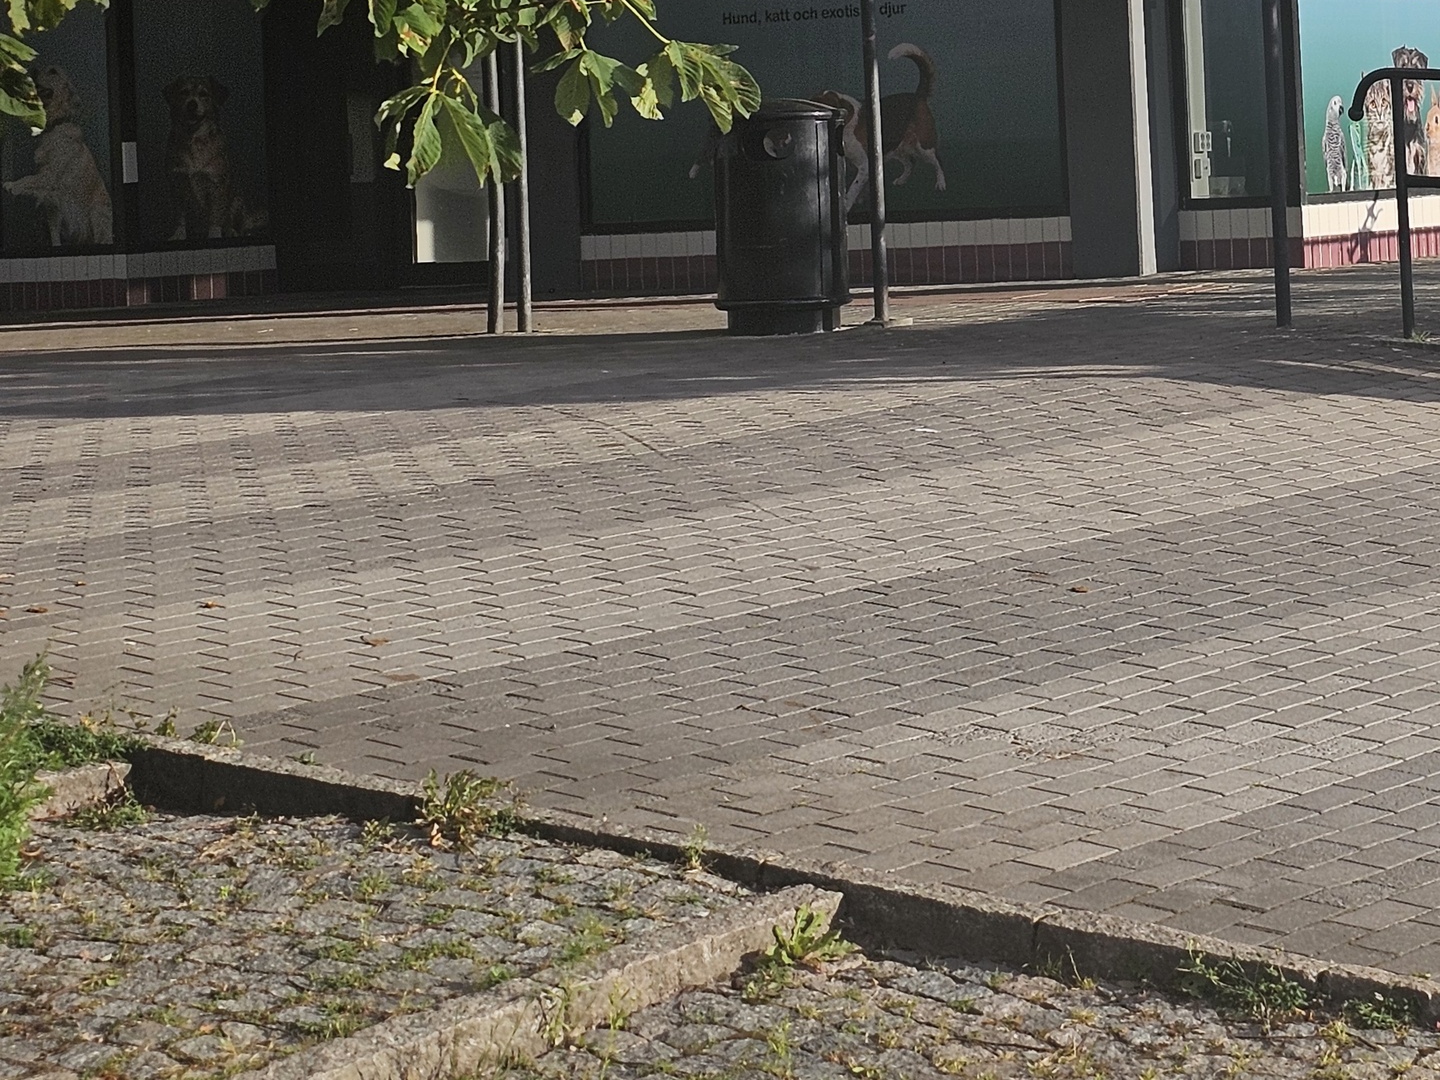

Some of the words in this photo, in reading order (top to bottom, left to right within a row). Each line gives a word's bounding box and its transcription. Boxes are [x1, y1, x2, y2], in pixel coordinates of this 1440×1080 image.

[722, 11, 762, 26] Hund,
[765, 8, 790, 23] katt
[793, 7, 818, 20] och
[821, 4, 860, 19] exotis
[879, 2, 908, 18] djur
